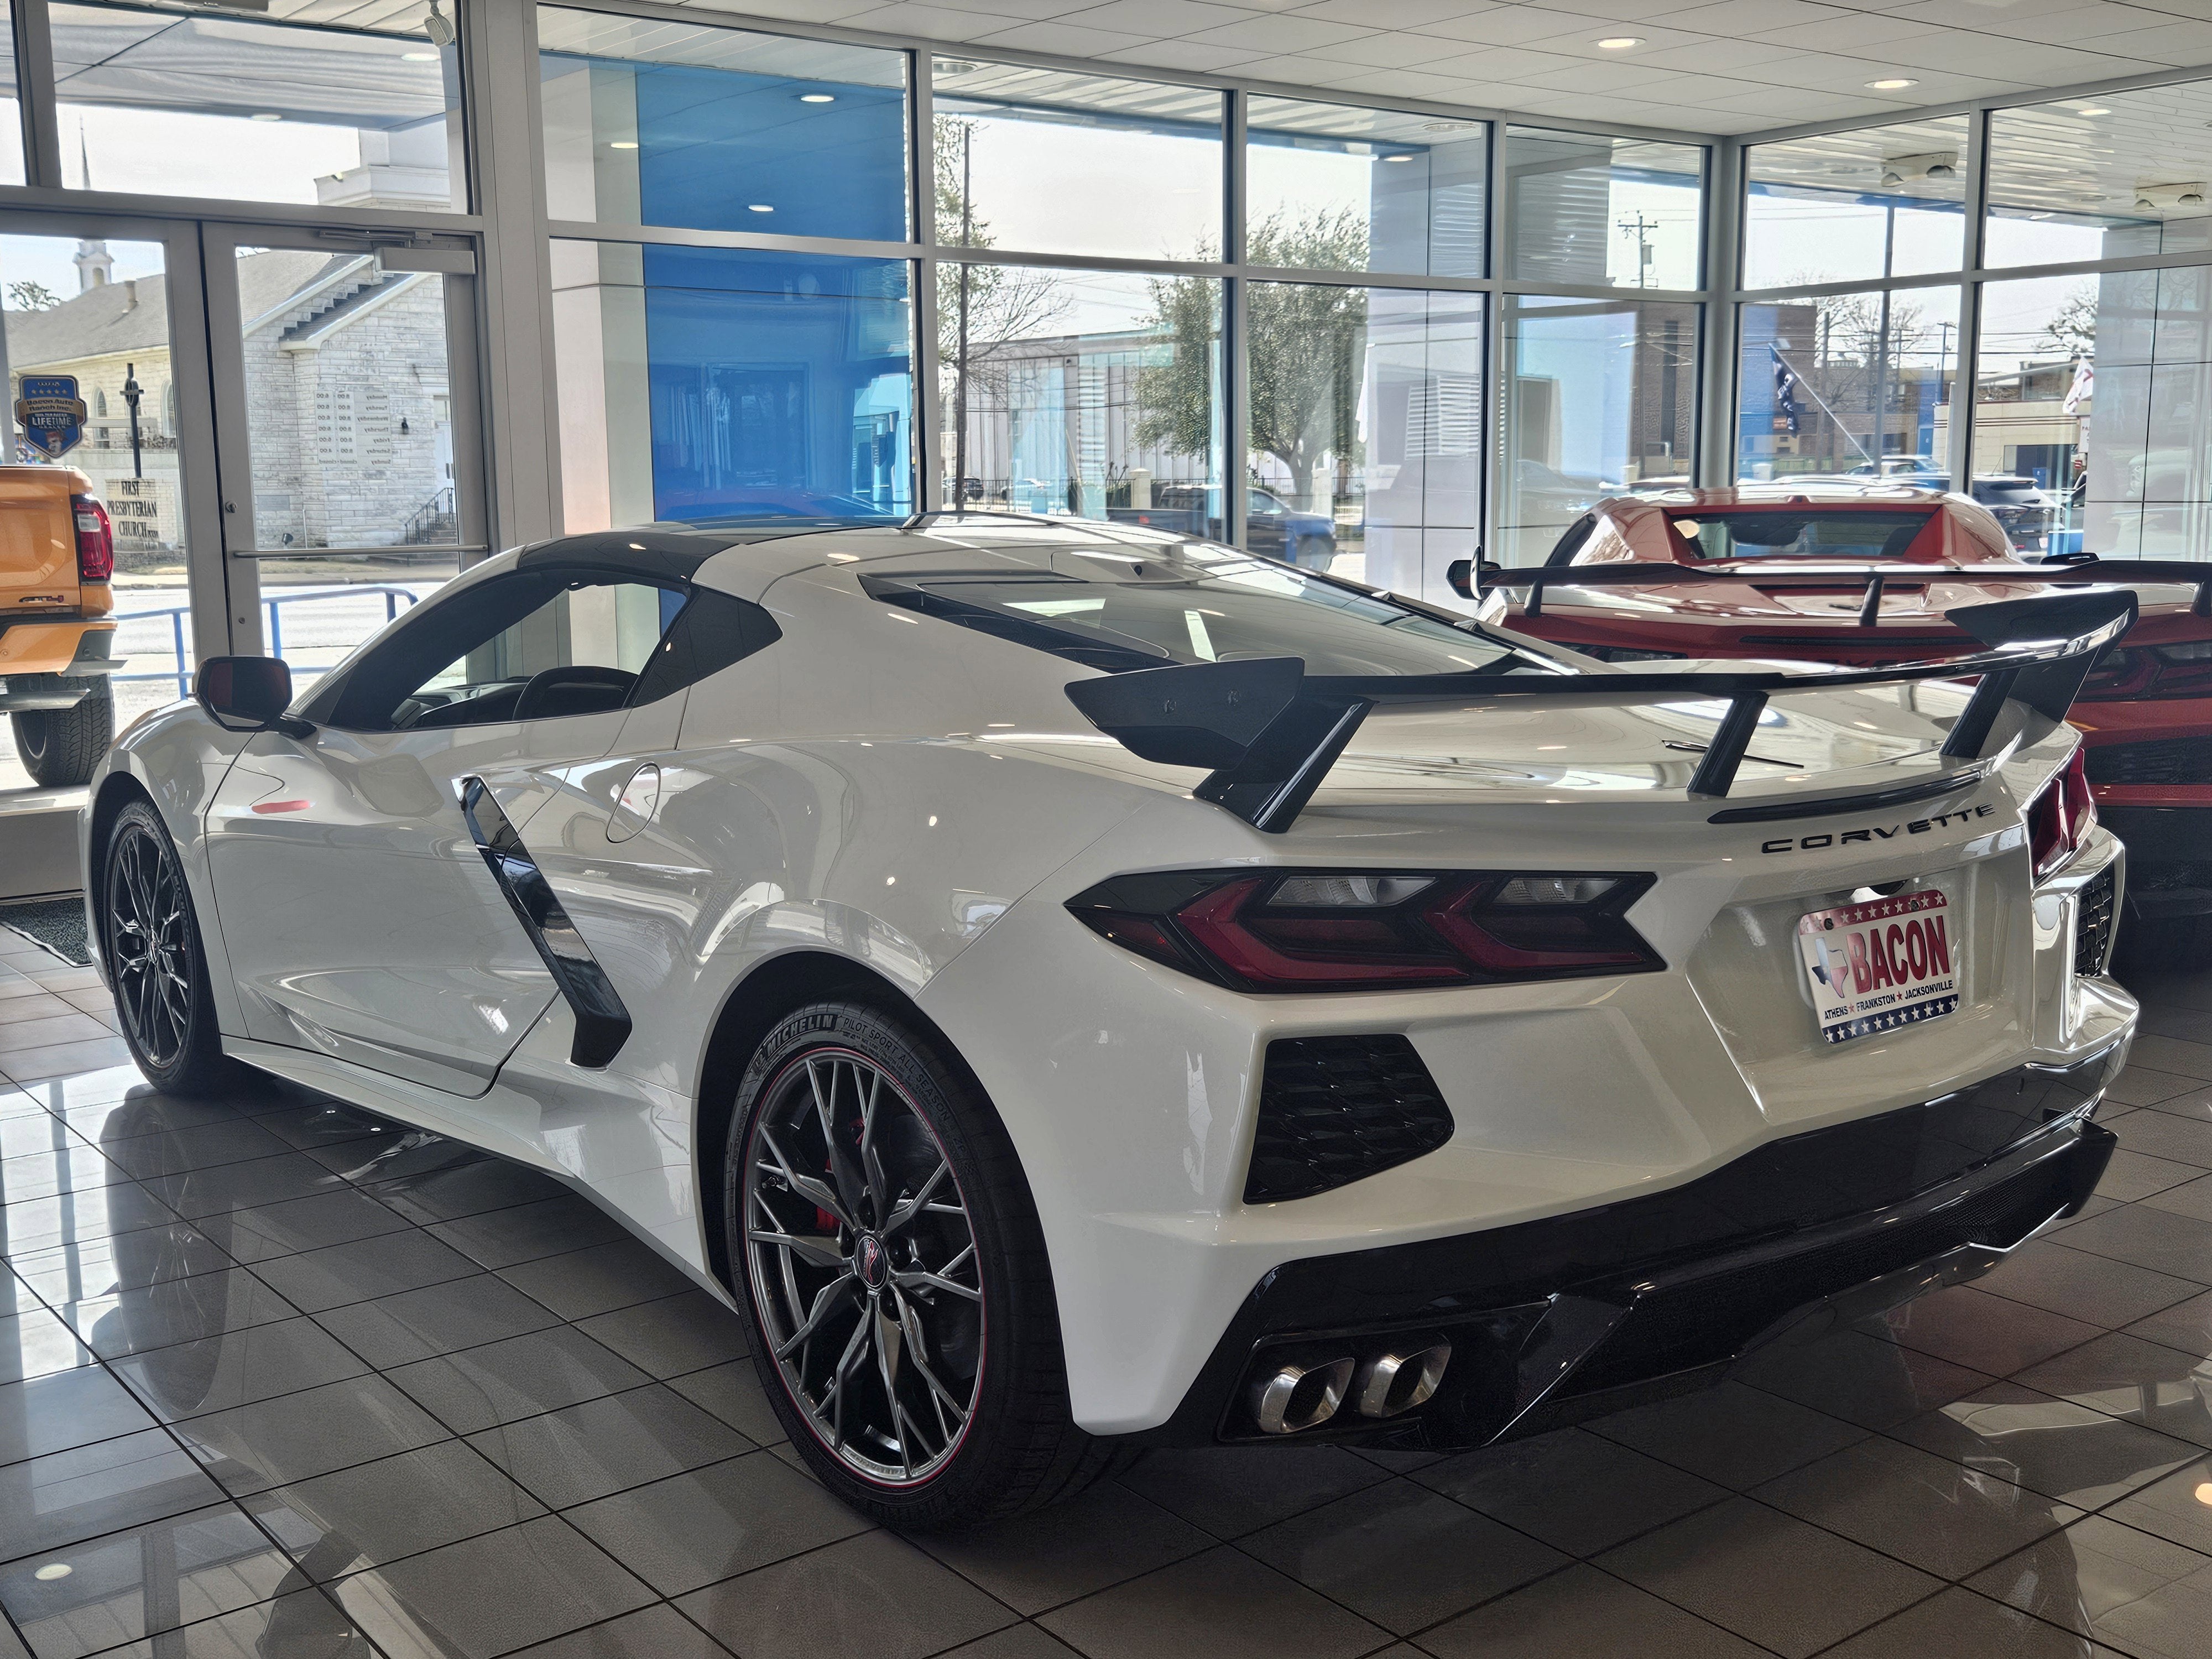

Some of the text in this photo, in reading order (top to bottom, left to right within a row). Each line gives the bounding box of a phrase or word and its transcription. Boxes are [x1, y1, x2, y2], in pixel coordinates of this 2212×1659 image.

[32, 416, 71, 425] LIFETIME
[121, 481, 140, 496] FIRST
[107, 500, 158, 518] PRESBYTERIAN
[118, 521, 147, 538] CHURCH
[1761, 802, 1996, 854] CORVETTE
[1845, 915, 1950, 994] BACON
[1824, 980, 1953, 1020] ATHENS FRANKSTON JACKSONVILLE
[767, 1014, 833, 1051] MICHELIN
[843, 1018, 868, 1035] PILOT
[869, 1029, 899, 1056] SPORT
[899, 1054, 915, 1074] ALL
[916, 1073, 951, 1122] SEASON
